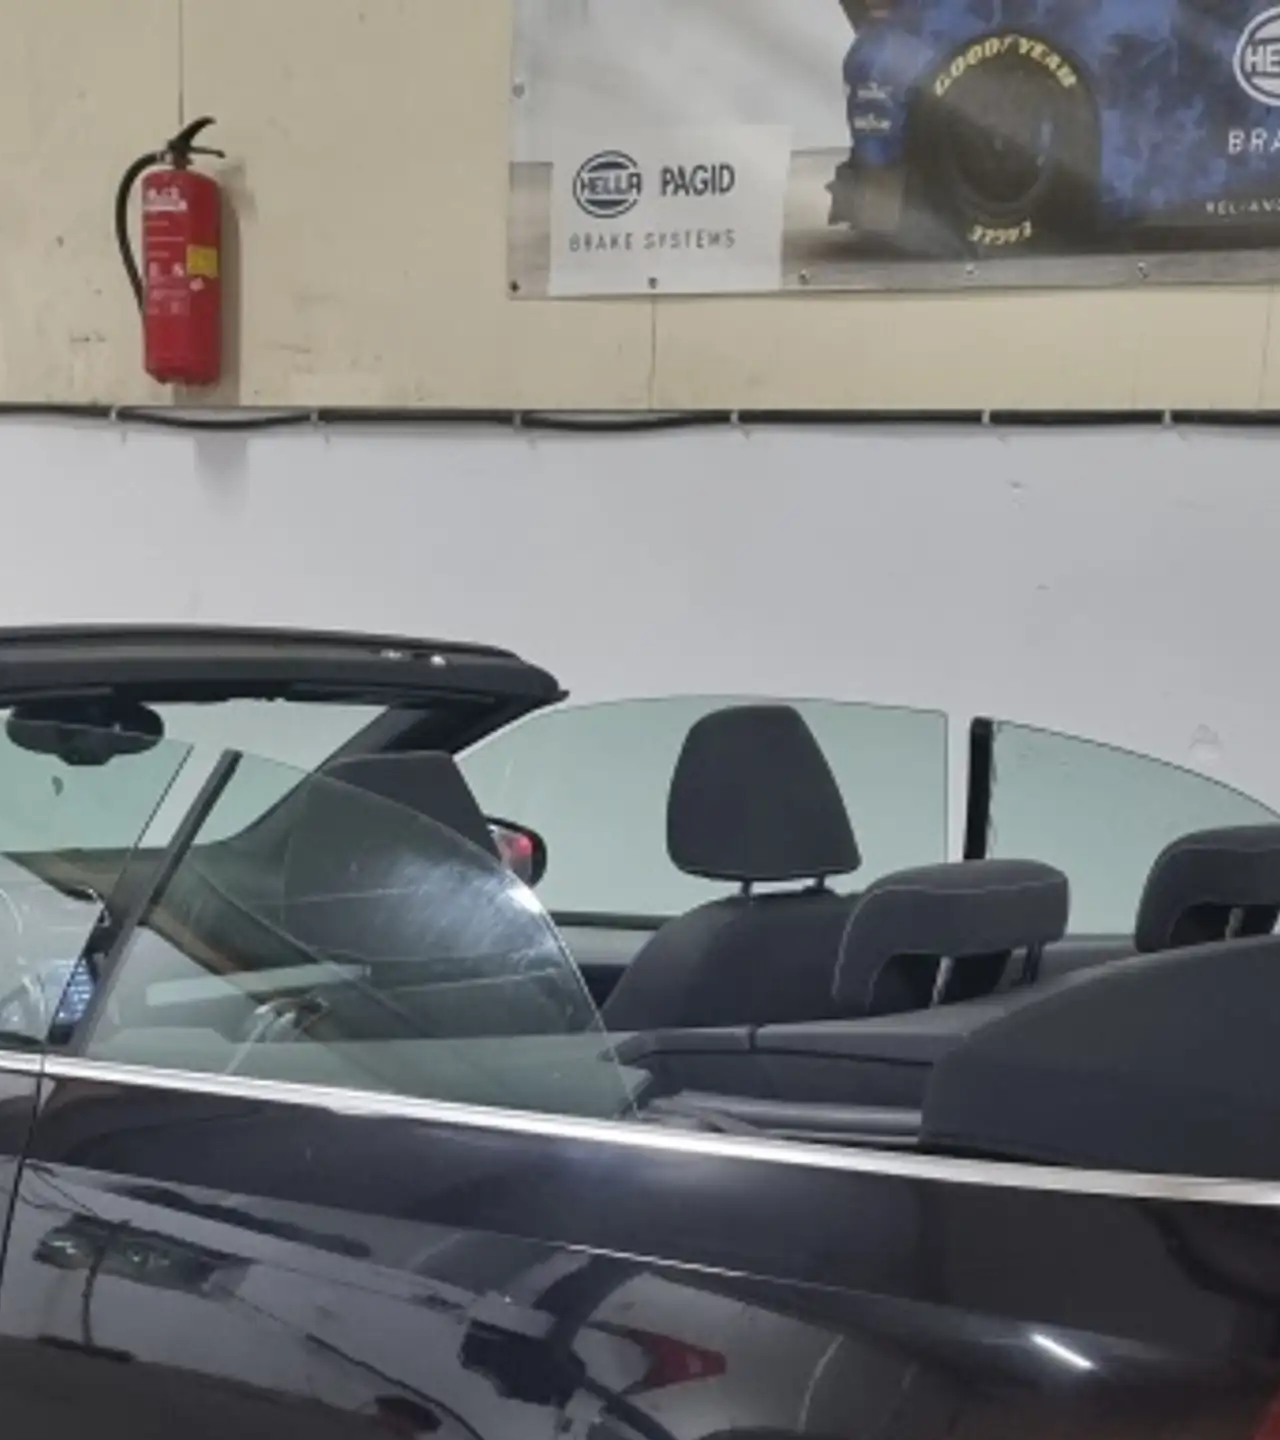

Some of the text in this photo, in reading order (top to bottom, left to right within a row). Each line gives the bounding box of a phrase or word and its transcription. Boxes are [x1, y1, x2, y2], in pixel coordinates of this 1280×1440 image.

[659, 163, 736, 197] PAGID
[569, 228, 736, 252] BRAKE SYSTEMS
